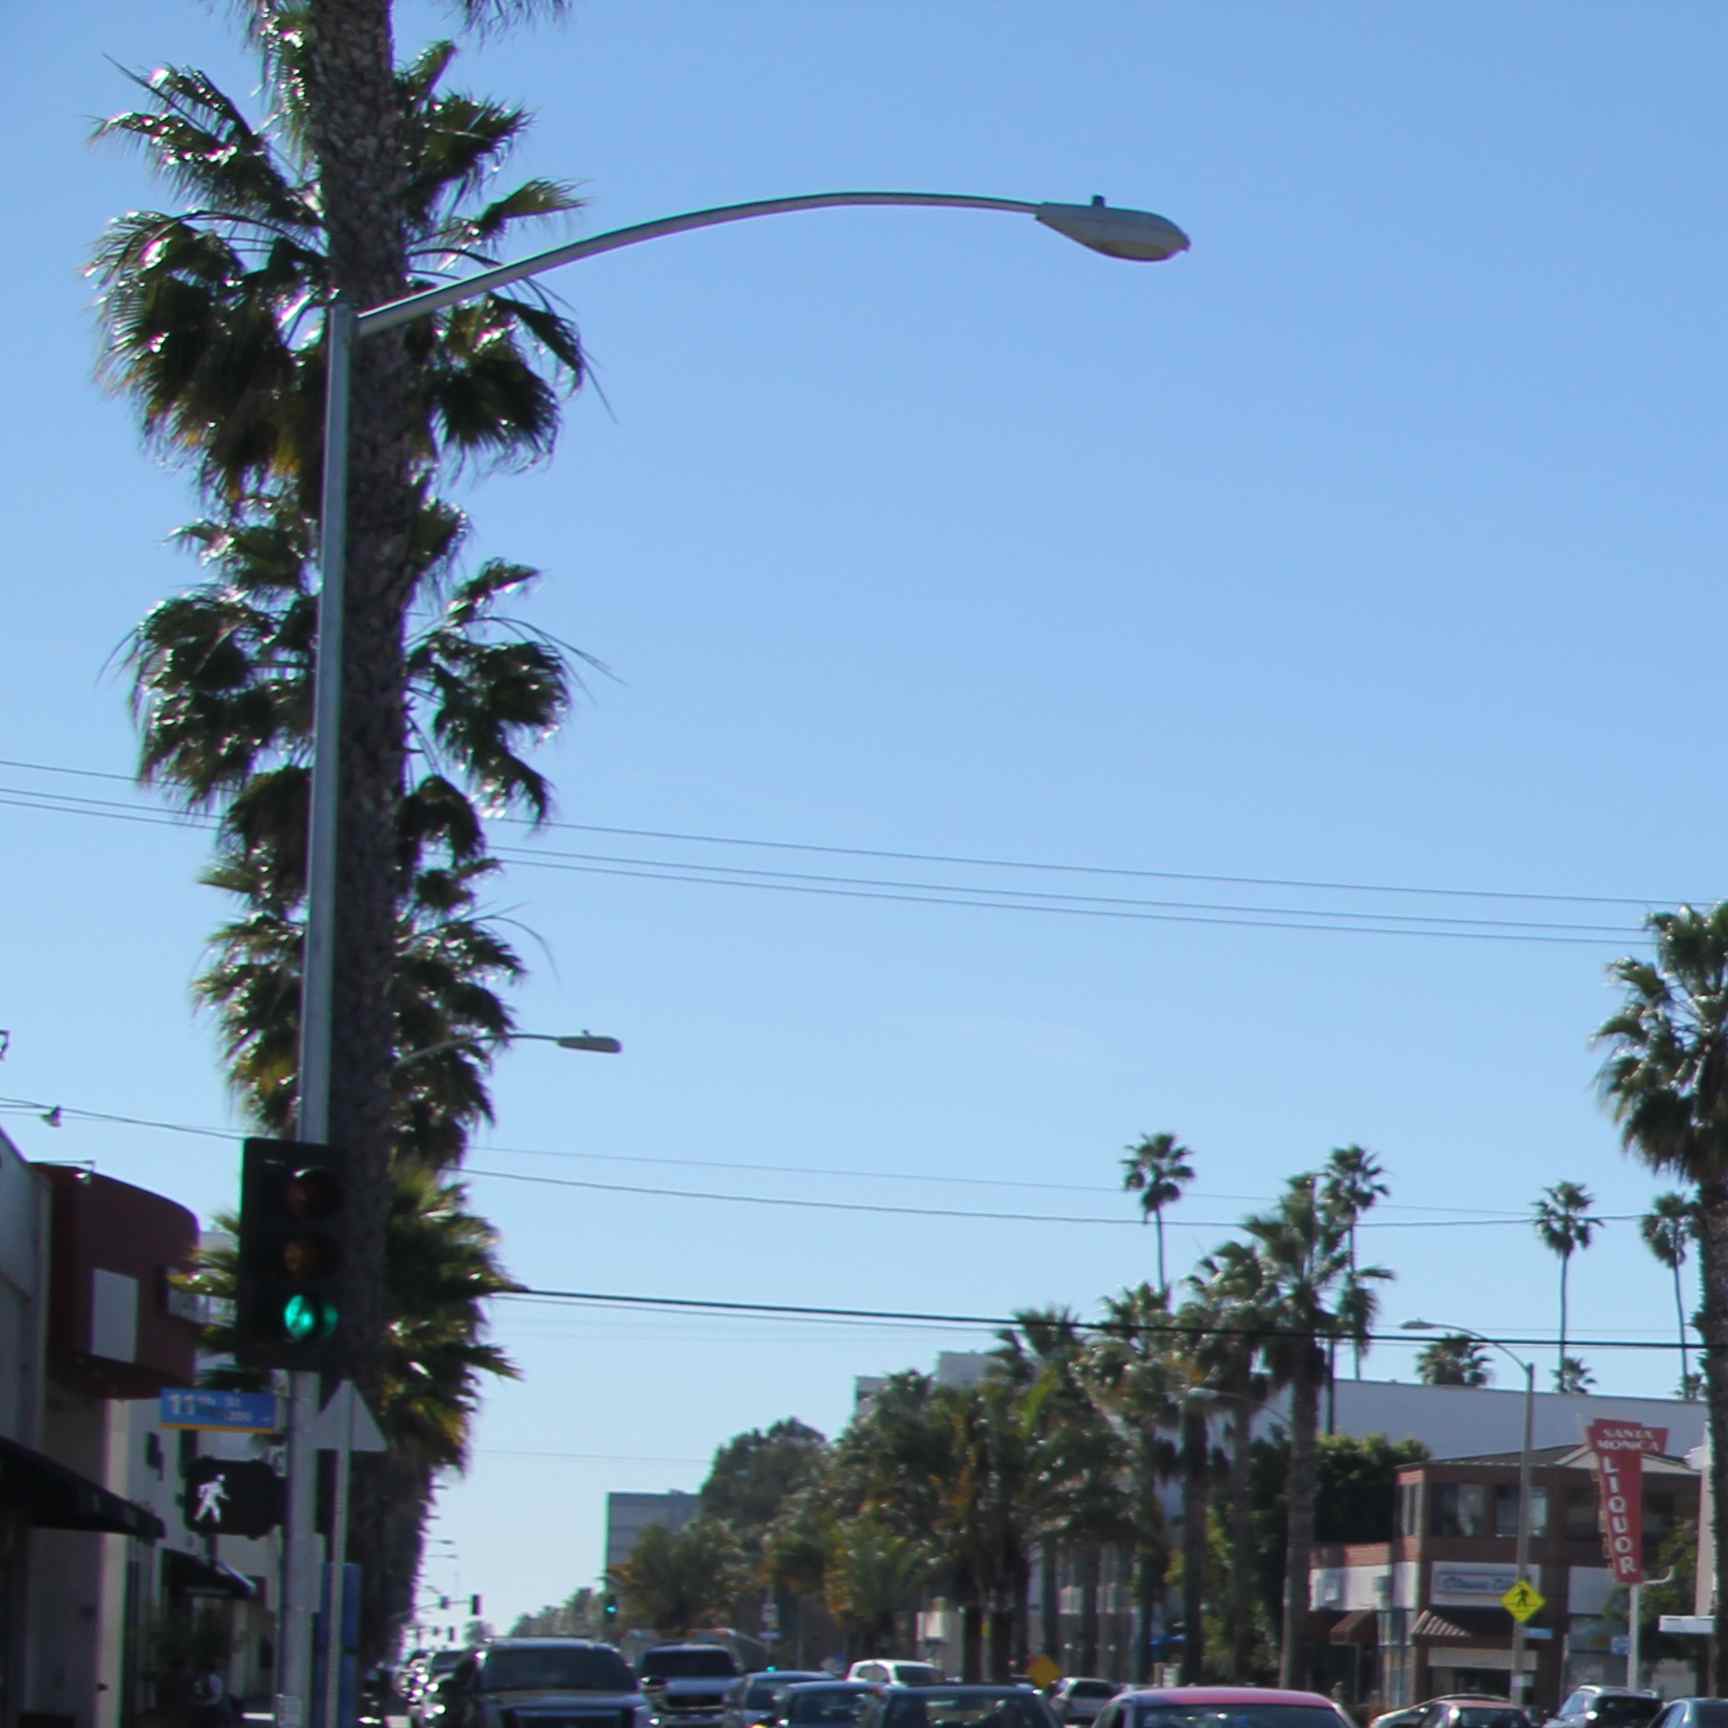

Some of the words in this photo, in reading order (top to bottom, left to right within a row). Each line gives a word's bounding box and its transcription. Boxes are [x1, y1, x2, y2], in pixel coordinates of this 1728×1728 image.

[1603, 1428, 1655, 1439] SANTA
[1597, 1439, 1660, 1452] MONICA
[1603, 1456, 1635, 1575] LIQUOR
